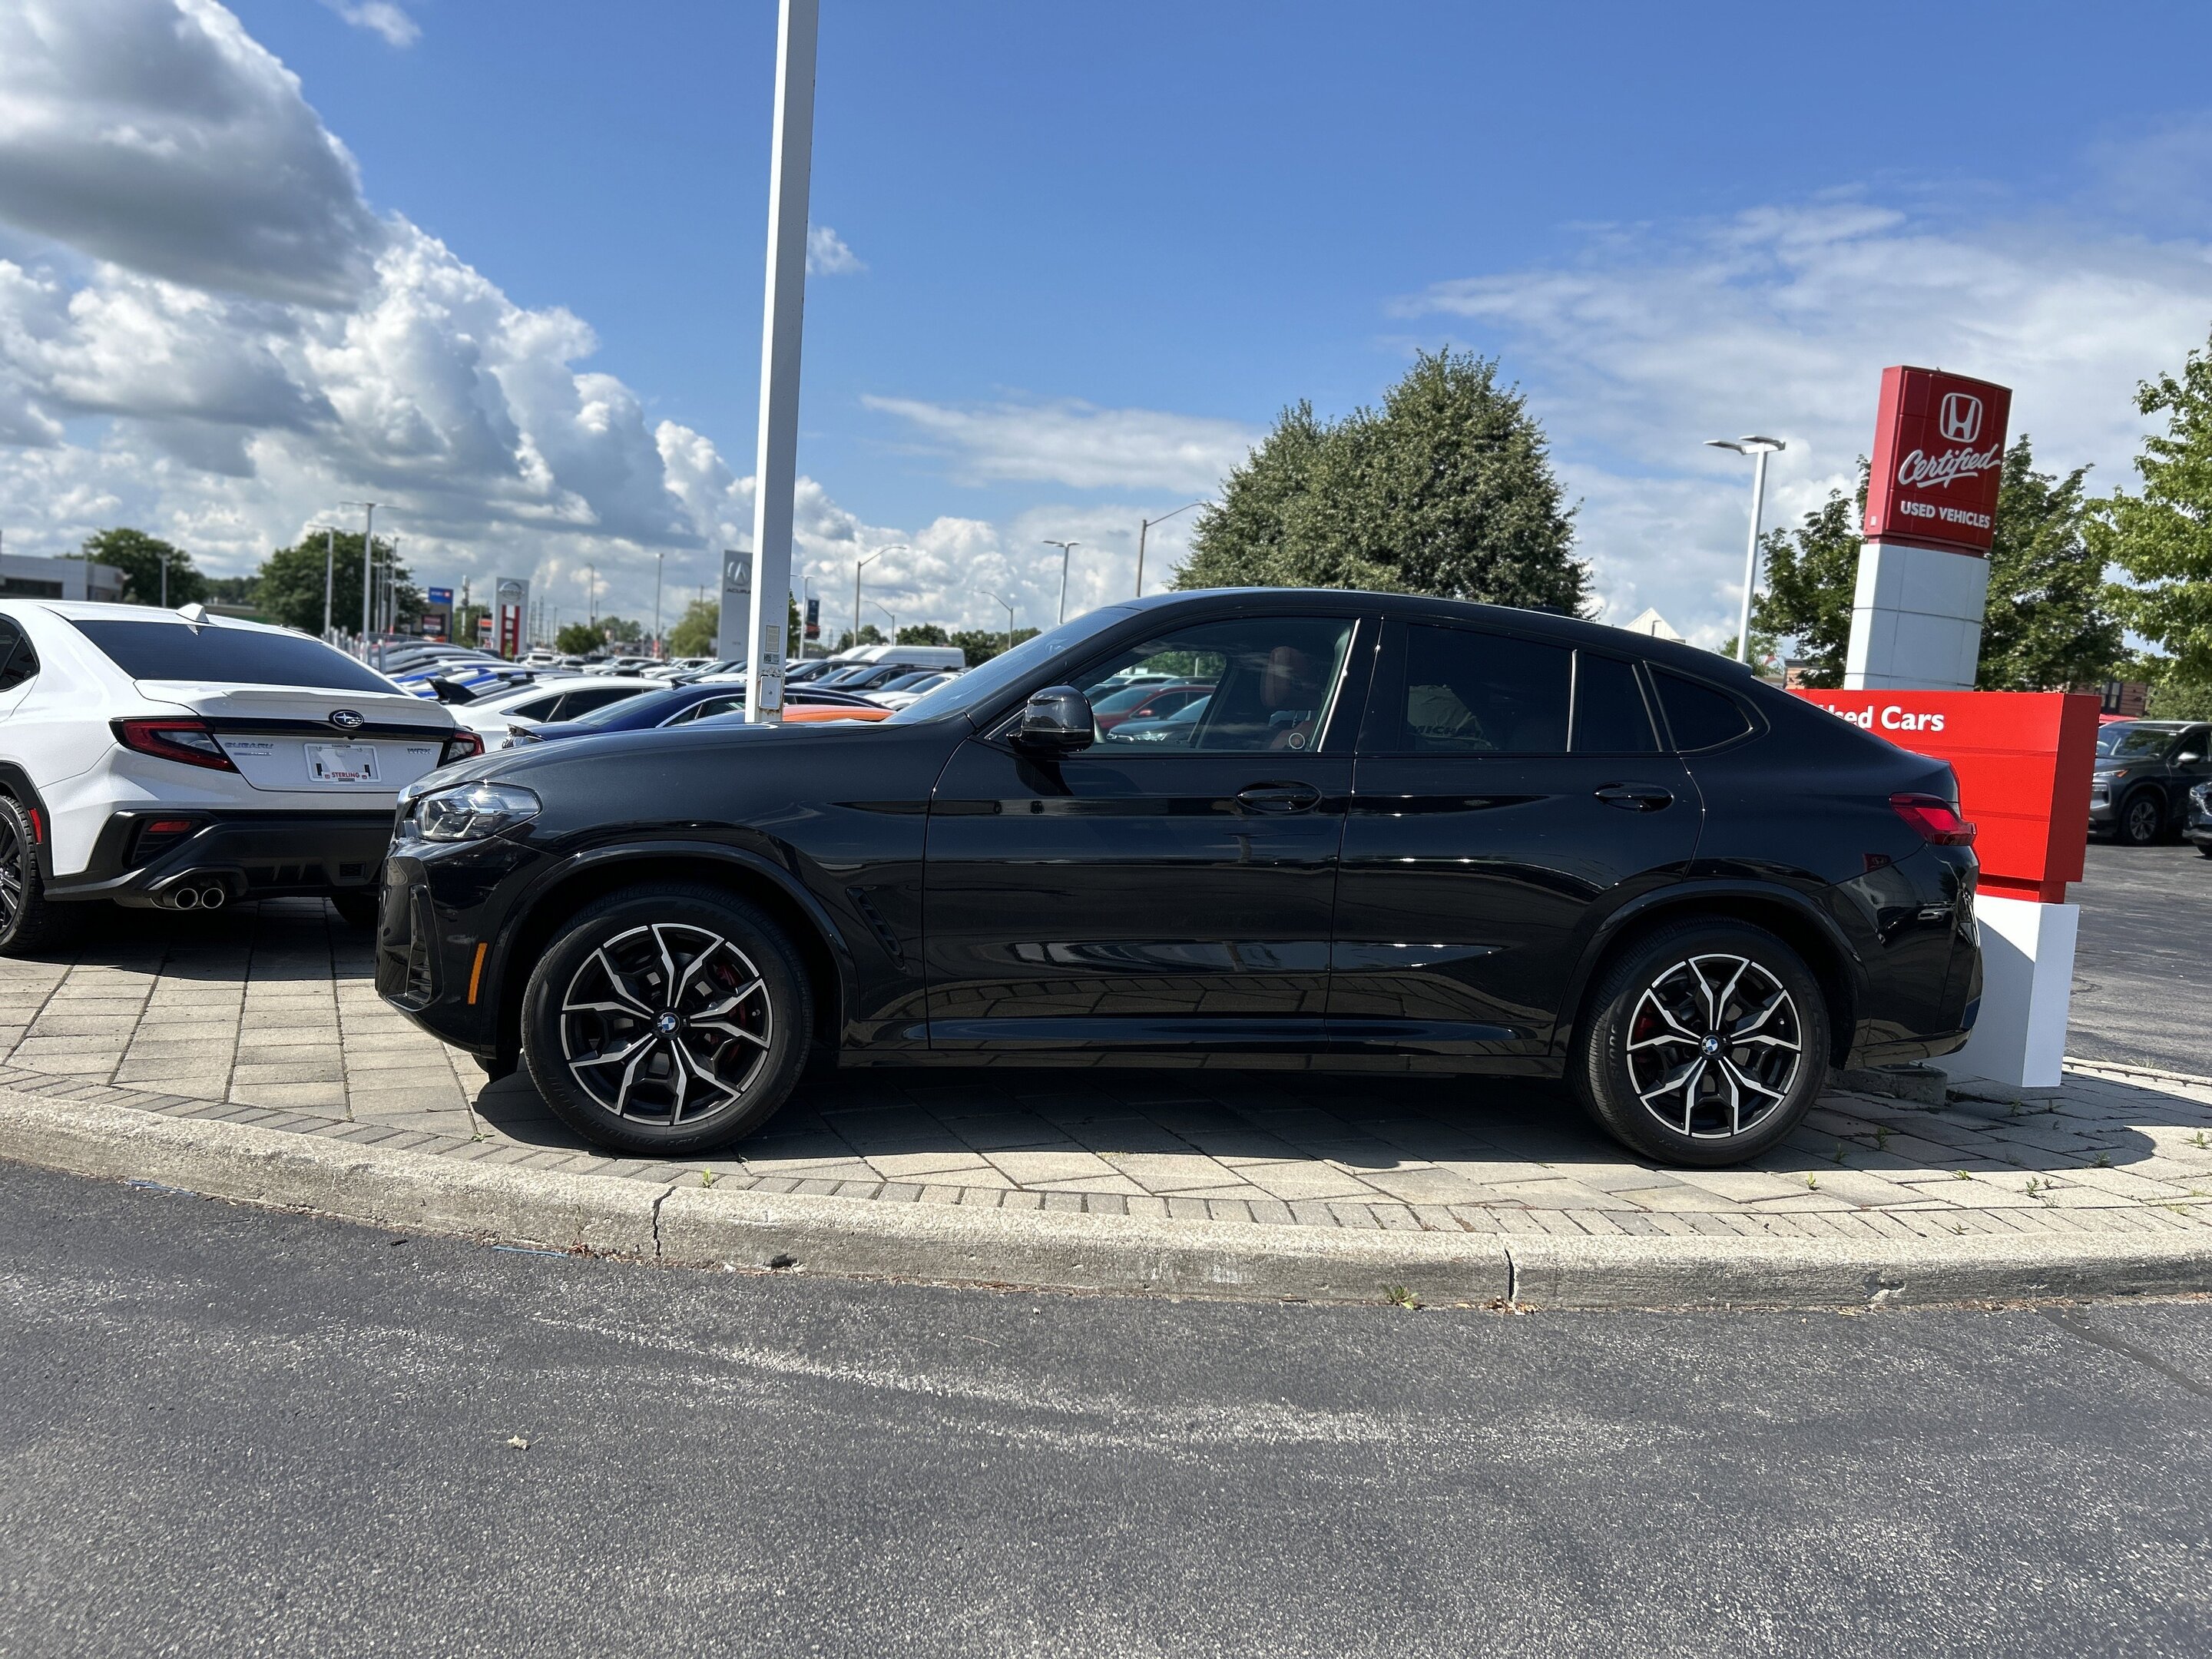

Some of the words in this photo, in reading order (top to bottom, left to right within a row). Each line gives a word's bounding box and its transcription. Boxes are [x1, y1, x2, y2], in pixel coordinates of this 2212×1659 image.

[1898, 443, 2002, 489] Certified
[1900, 500, 1936, 518] USED
[1939, 507, 1991, 529] VEHICLES
[1881, 705, 1945, 732] Cars
[224, 741, 274, 750] SUBARU
